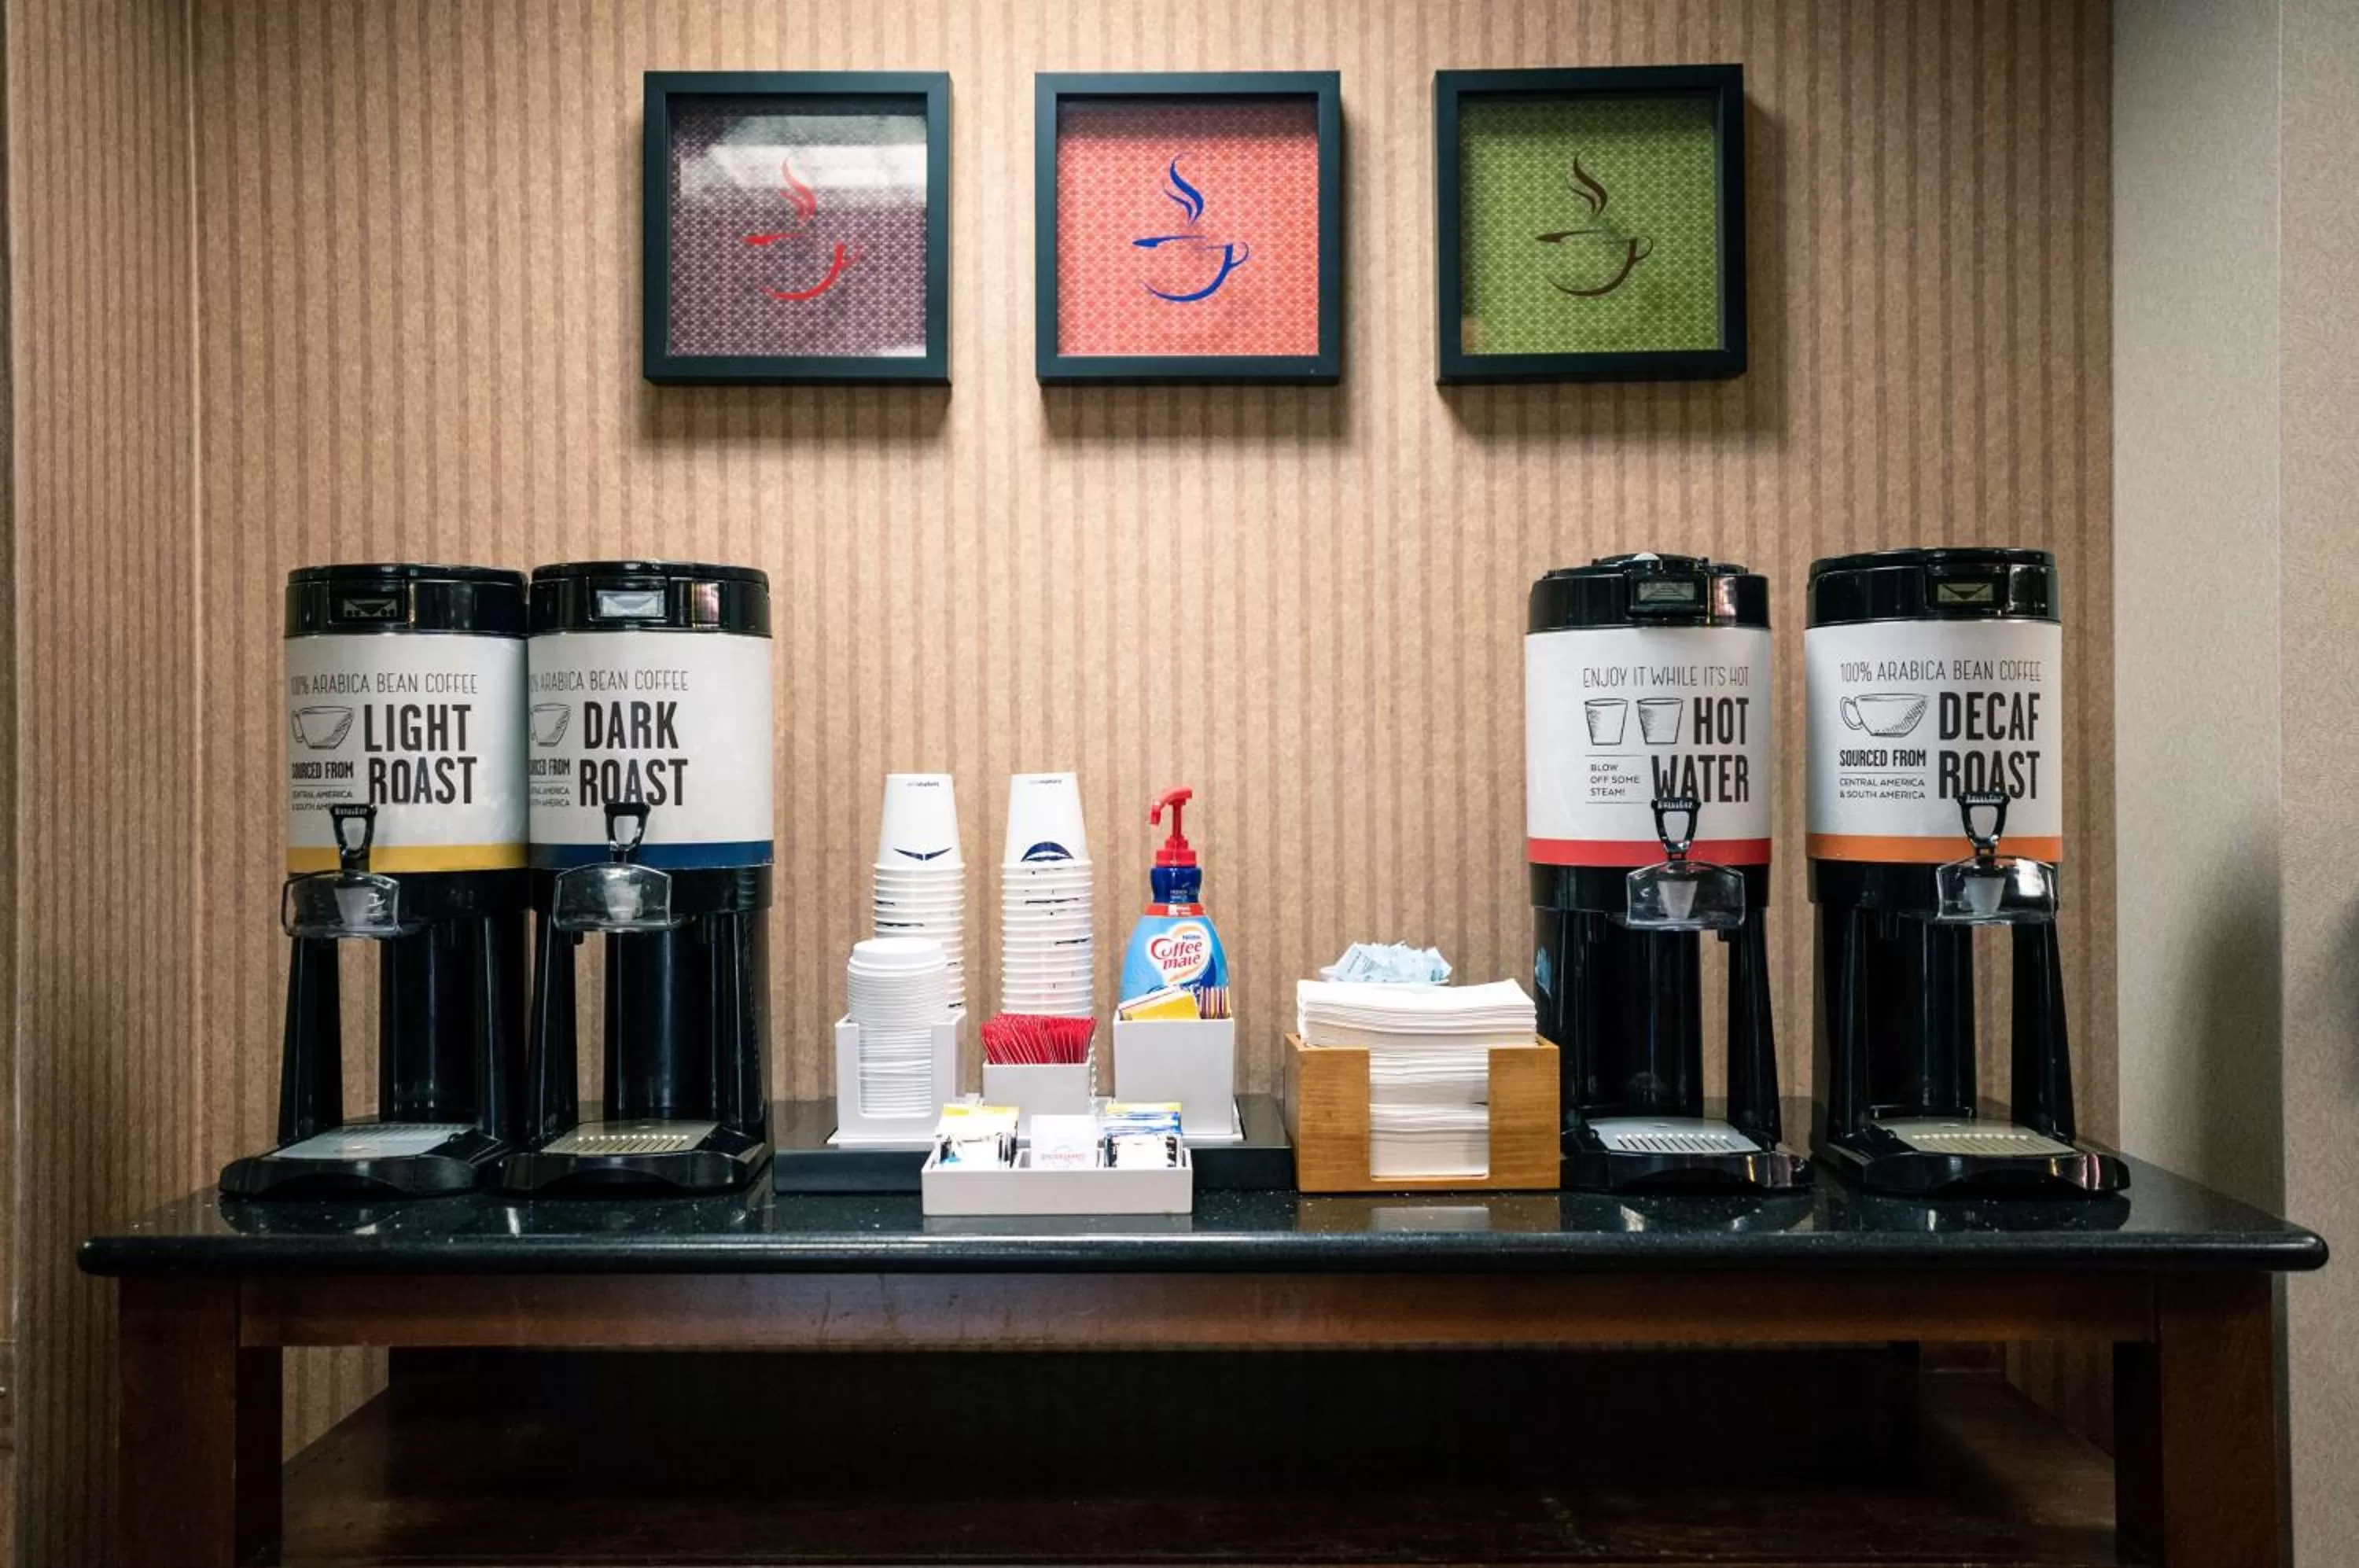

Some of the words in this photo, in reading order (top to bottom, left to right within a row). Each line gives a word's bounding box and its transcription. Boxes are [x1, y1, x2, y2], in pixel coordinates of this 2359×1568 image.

[313, 673, 370, 693] ARABICA
[377, 672, 418, 693] BEAN
[425, 673, 477, 694] COFFEE
[591, 671, 627, 690] BEAN
[635, 670, 689, 691] COFFEE
[1584, 667, 1627, 687] ENJOY
[1633, 666, 1647, 686] IT
[1651, 666, 1697, 686] WHILE
[1704, 666, 1726, 686] IT'S
[1730, 667, 1750, 686] HOT
[1840, 662, 1872, 683] 100%
[1877, 661, 1946, 681] ARABICA
[1953, 661, 1994, 680] BEAN
[2000, 661, 2041, 681] COFFEE
[584, 701, 679, 749] DARK
[1694, 697, 1750, 745] HOT
[1939, 692, 2041, 740] DECAF
[364, 705, 471, 752] LIGHT
[549, 758, 570, 775] FROM
[1591, 764, 1619, 772] BLOW
[1840, 749, 1887, 767] SOURCED
[1893, 749, 1926, 767] FROM
[325, 761, 353, 778] FROM
[369, 757, 477, 804] ROAST
[1590, 776, 1609, 785] OFF
[1611, 775, 1640, 784] SOME
[1651, 755, 1750, 803] WATER
[1939, 750, 2041, 800] ROAST
[580, 759, 688, 806] ROAST
[1840, 778, 1878, 787] CENTRAL
[1880, 778, 1926, 787] AMERICA
[1846, 790, 1877, 799] SOUTH
[1879, 790, 1926, 800] AMERICA
[1150, 937, 1202, 960] Coffee
